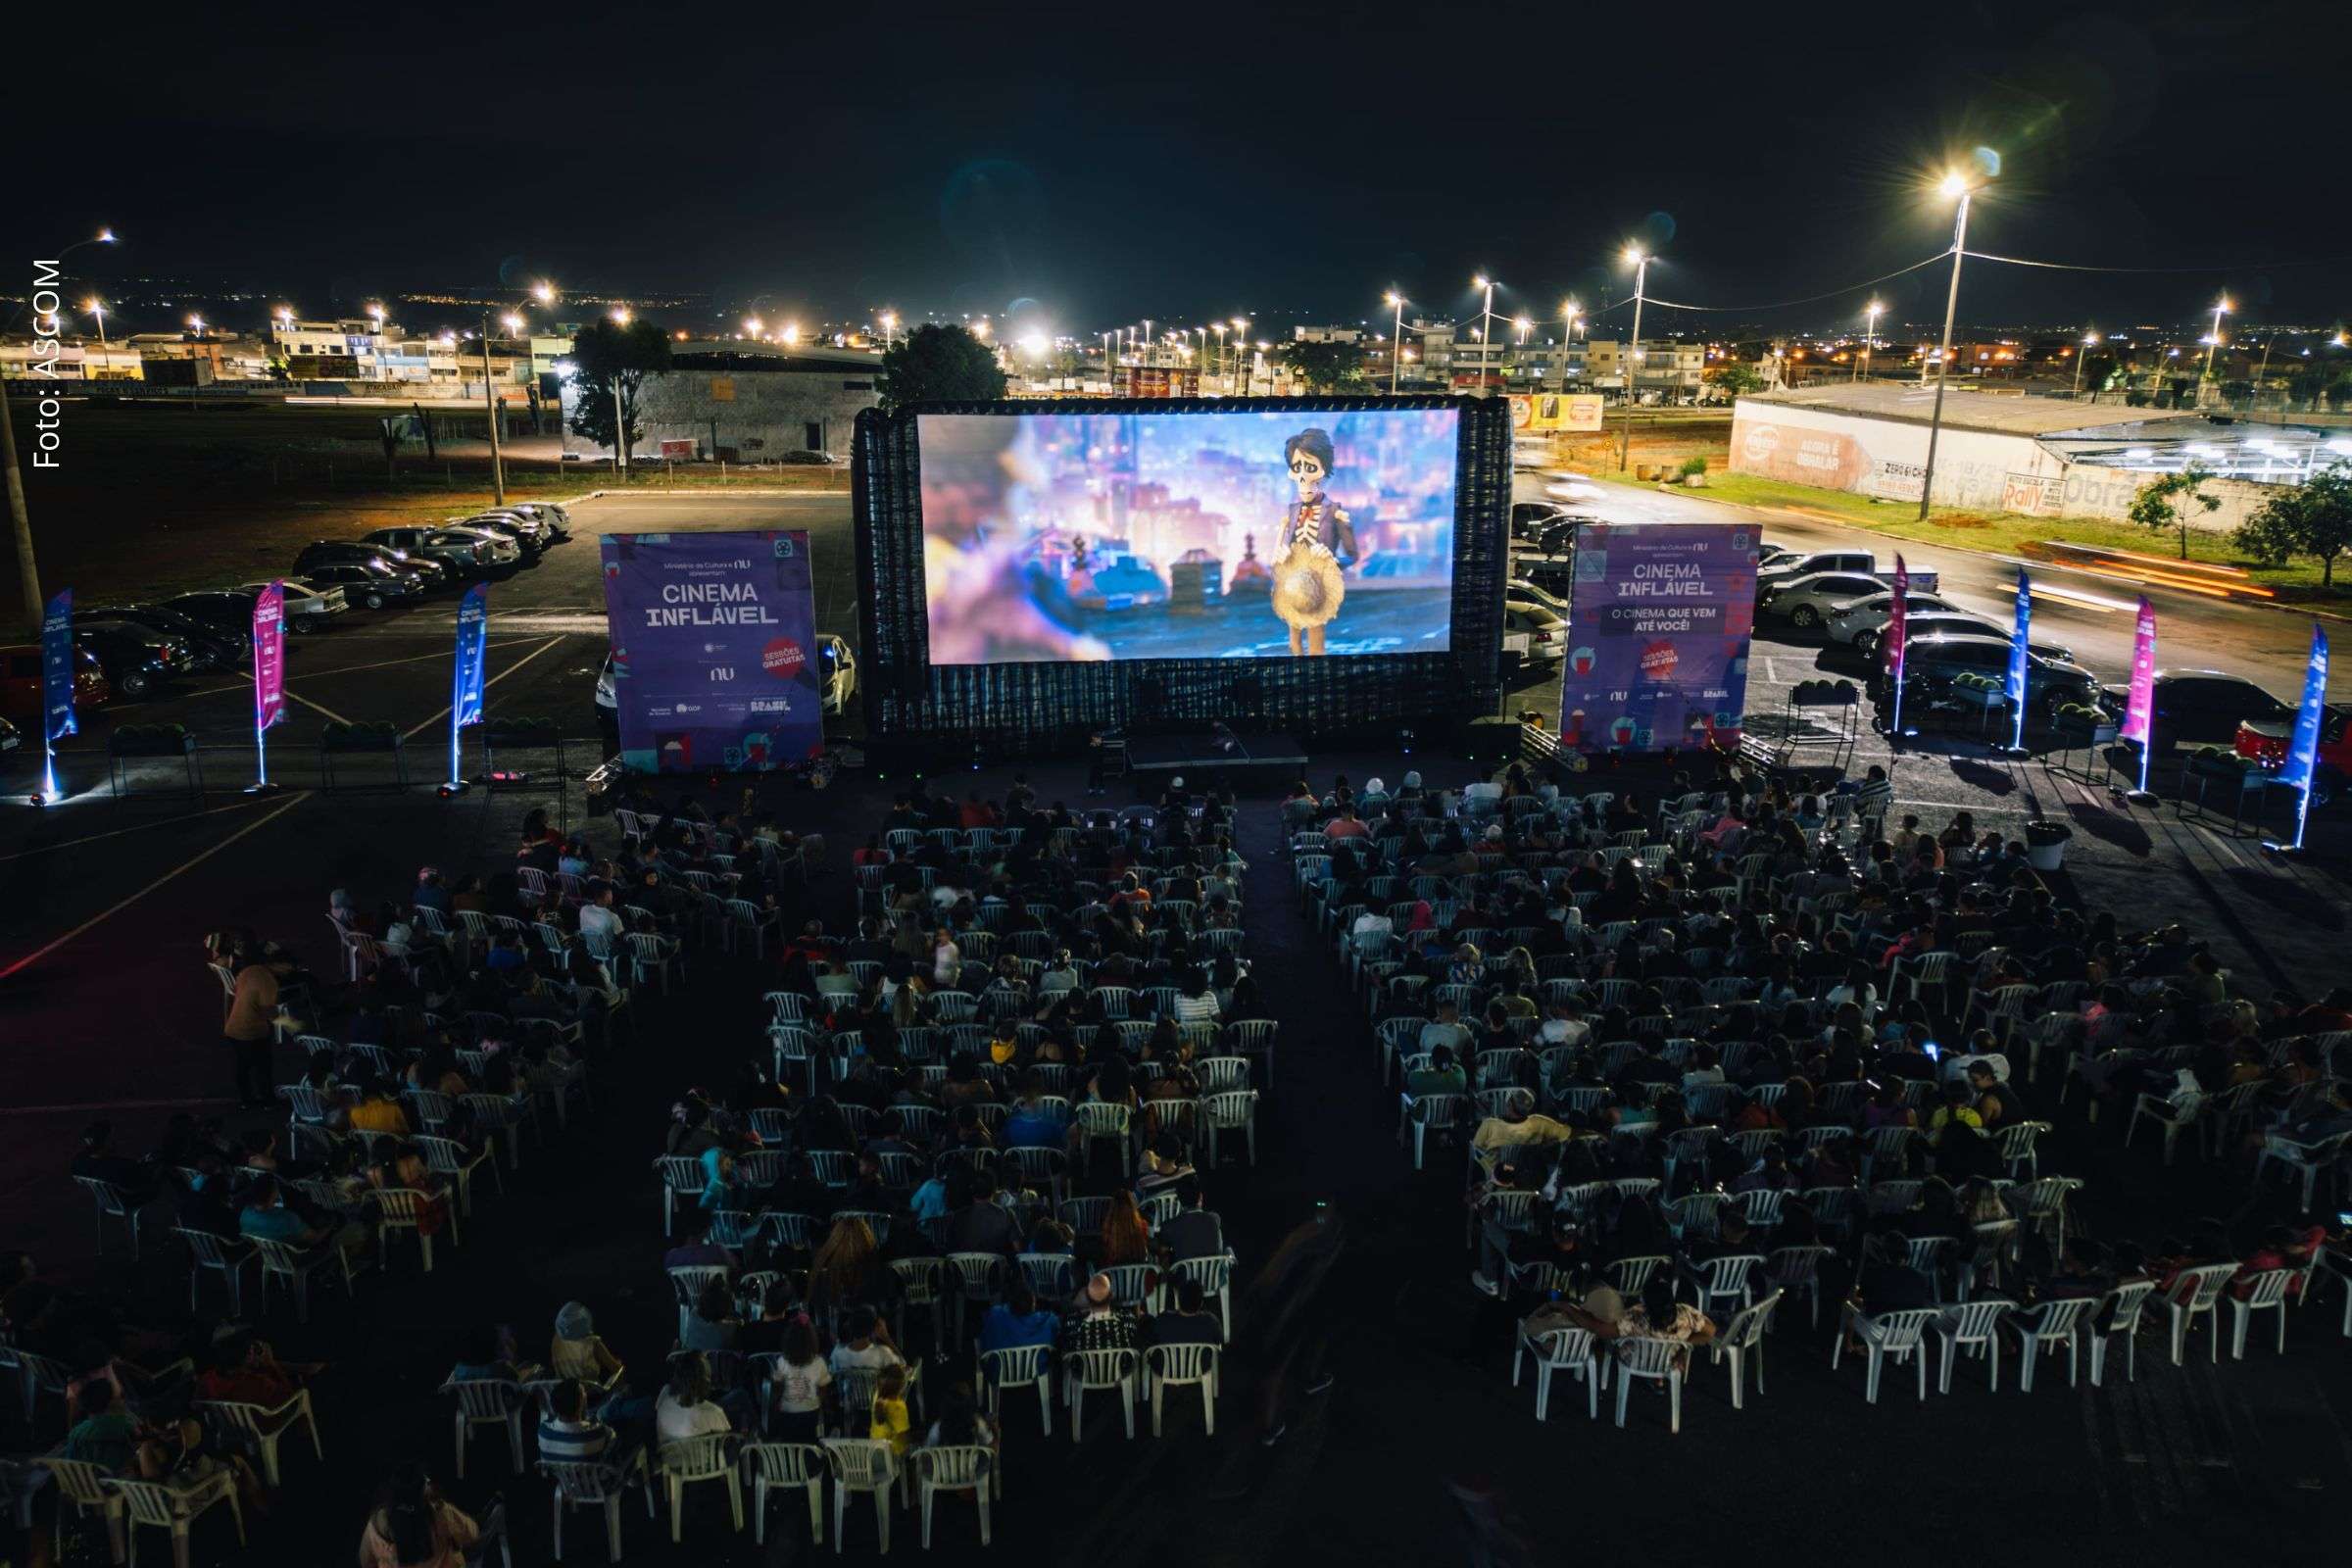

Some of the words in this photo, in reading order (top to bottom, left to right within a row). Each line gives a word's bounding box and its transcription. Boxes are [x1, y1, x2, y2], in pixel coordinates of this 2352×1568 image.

[2004, 483, 2045, 513] Rally
[1634, 564, 1701, 579] CINEMA
[662, 583, 759, 604] CINEMA
[1618, 577, 1713, 597] INFLÁVEL
[646, 603, 779, 627] INFLÁVEL
[1611, 609, 1622, 618] O
[1623, 609, 1665, 618] CINEMA
[1668, 609, 1690, 618] QUE
[1692, 608, 1717, 617] VEM
[1634, 618, 1654, 631] ATÉ
[1656, 618, 1690, 631] VOCÊ!
[762, 654, 806, 668] GRATUITAS
[764, 647, 800, 662] SESSÕES
